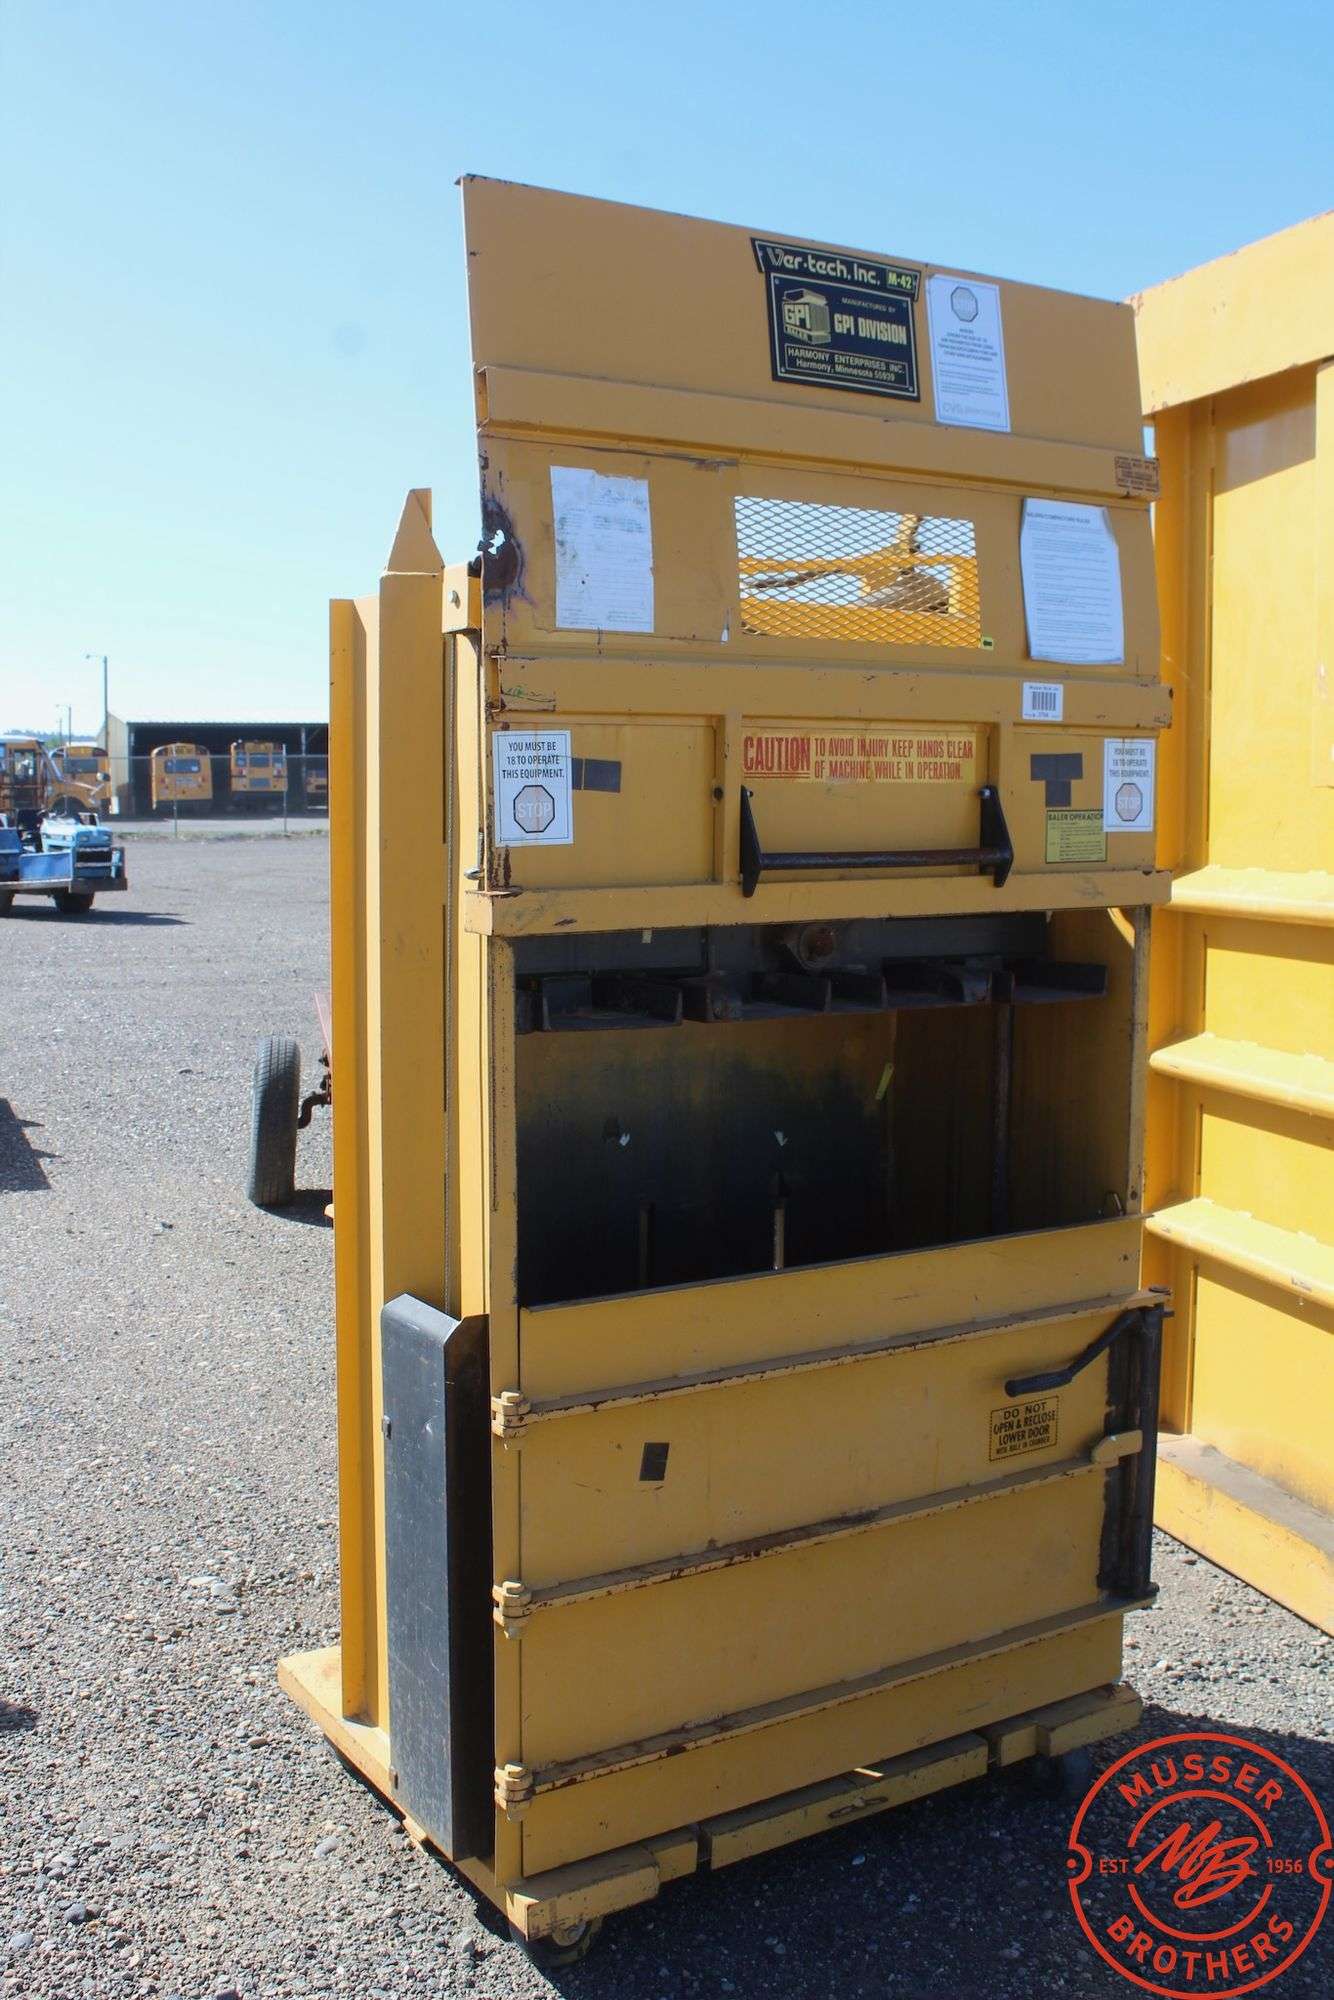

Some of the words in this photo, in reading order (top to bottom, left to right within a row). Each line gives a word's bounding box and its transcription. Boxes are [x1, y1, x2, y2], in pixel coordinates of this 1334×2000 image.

[853, 263, 880, 285] Inc.
[784, 304, 811, 329] GPI
[834, 313, 855, 335] GPI
[858, 317, 907, 345] DIVISION
[788, 347, 830, 361] HARMONY
[835, 364, 873, 378] Minnesota
[508, 742, 524, 752] YOU
[524, 741, 545, 751] MUST
[547, 741, 557, 751] BE
[743, 736, 811, 771] CAUTION
[814, 737, 826, 756] TO
[828, 737, 854, 757] AVOID
[857, 738, 888, 758] INJURY
[891, 739, 913, 758] KEEP
[917, 739, 944, 759] HANDS
[947, 740, 974, 759] CLEAR
[507, 756, 515, 765] 18
[516, 755, 526, 765] TO
[527, 754, 560, 765] OPERATE
[502, 769, 519, 779] THIS
[520, 768, 565, 779] EQUIPMENT.
[814, 760, 826, 778] OF
[829, 760, 871, 779] MACHINE
[874, 761, 901, 780] WHILE
[905, 762, 914, 780] IN
[517, 801, 551, 818] STOP
[1003, 1408, 1020, 1420] DO
[1024, 1402, 1047, 1415] NOT
[993, 1420, 1014, 1435] OPEN
[1015, 1419, 1022, 1429] &
[1024, 1410, 1056, 1426] RECLOSE
[998, 1430, 1026, 1446] LOWER
[1028, 1424, 1050, 1439] DOOR
